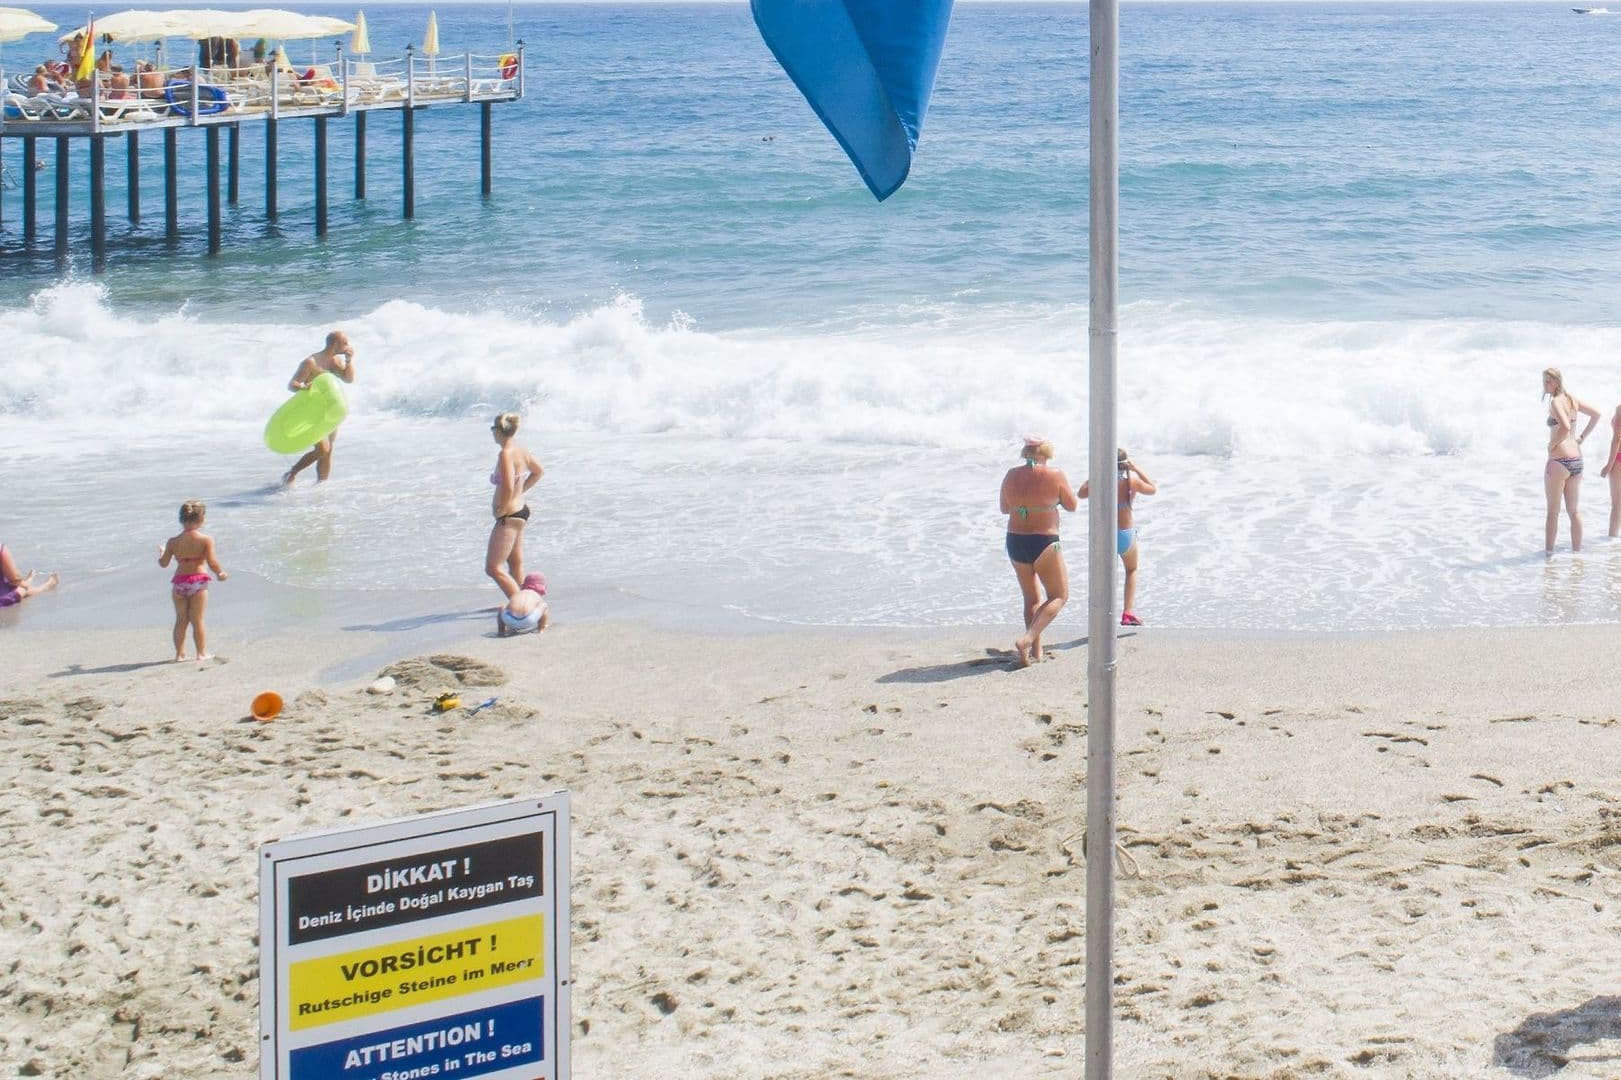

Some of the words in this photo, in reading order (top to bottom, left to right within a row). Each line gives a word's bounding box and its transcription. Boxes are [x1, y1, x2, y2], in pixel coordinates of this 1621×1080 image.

[367, 860, 457, 893] DİKKAT
[463, 857, 470, 875] !
[298, 911, 342, 930] Deniz
[347, 904, 395, 922] İçinde
[399, 891, 443, 910] Doğal
[448, 881, 504, 901] Kaygan
[508, 875, 534, 889] Taş
[340, 938, 482, 982] VORSİCHT
[490, 934, 498, 952] !
[299, 989, 393, 1016] Rutschige
[399, 974, 457, 995] Steine
[463, 968, 484, 982] im
[344, 1022, 481, 1069] ATTENTION
[488, 1019, 495, 1038] !
[381, 1063, 440, 1080] Stones
[445, 1058, 461, 1071] in
[465, 1049, 497, 1066] The
[501, 1042, 533, 1058] Sea
